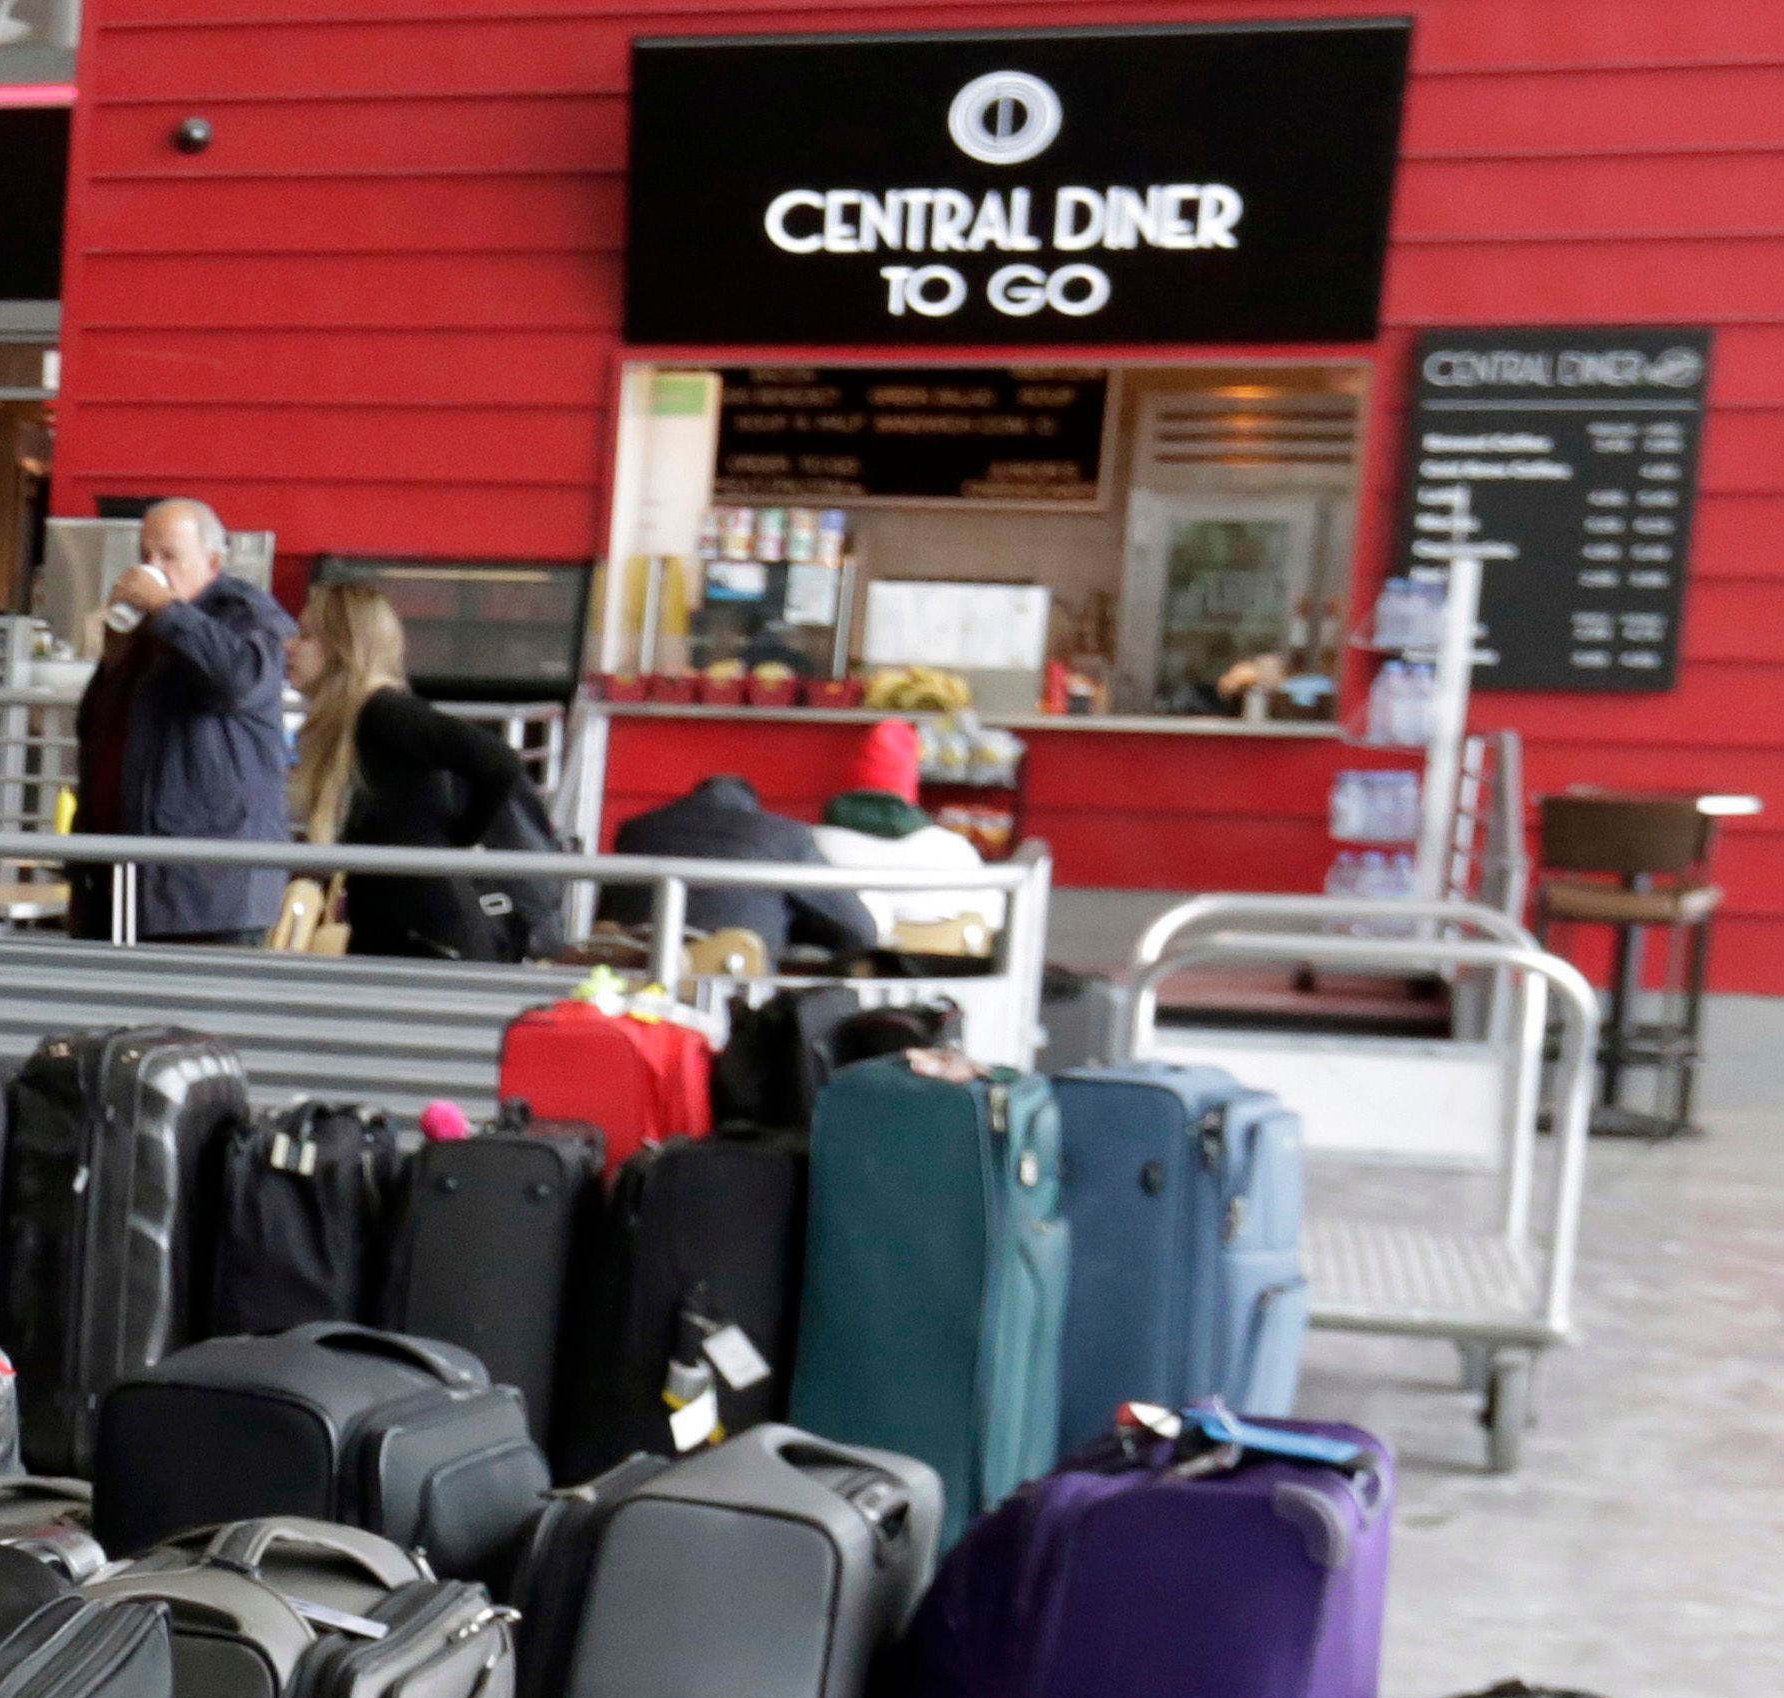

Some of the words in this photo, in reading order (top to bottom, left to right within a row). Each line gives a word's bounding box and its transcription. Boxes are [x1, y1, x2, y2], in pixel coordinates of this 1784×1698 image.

[765, 188, 1042, 255] CENTRAL
[1053, 183, 1244, 252] DINER
[880, 264, 968, 317] TO
[986, 263, 1111, 316] GO
[1423, 350, 1553, 388] CENTRAL
[1556, 350, 1648, 388] DINER
